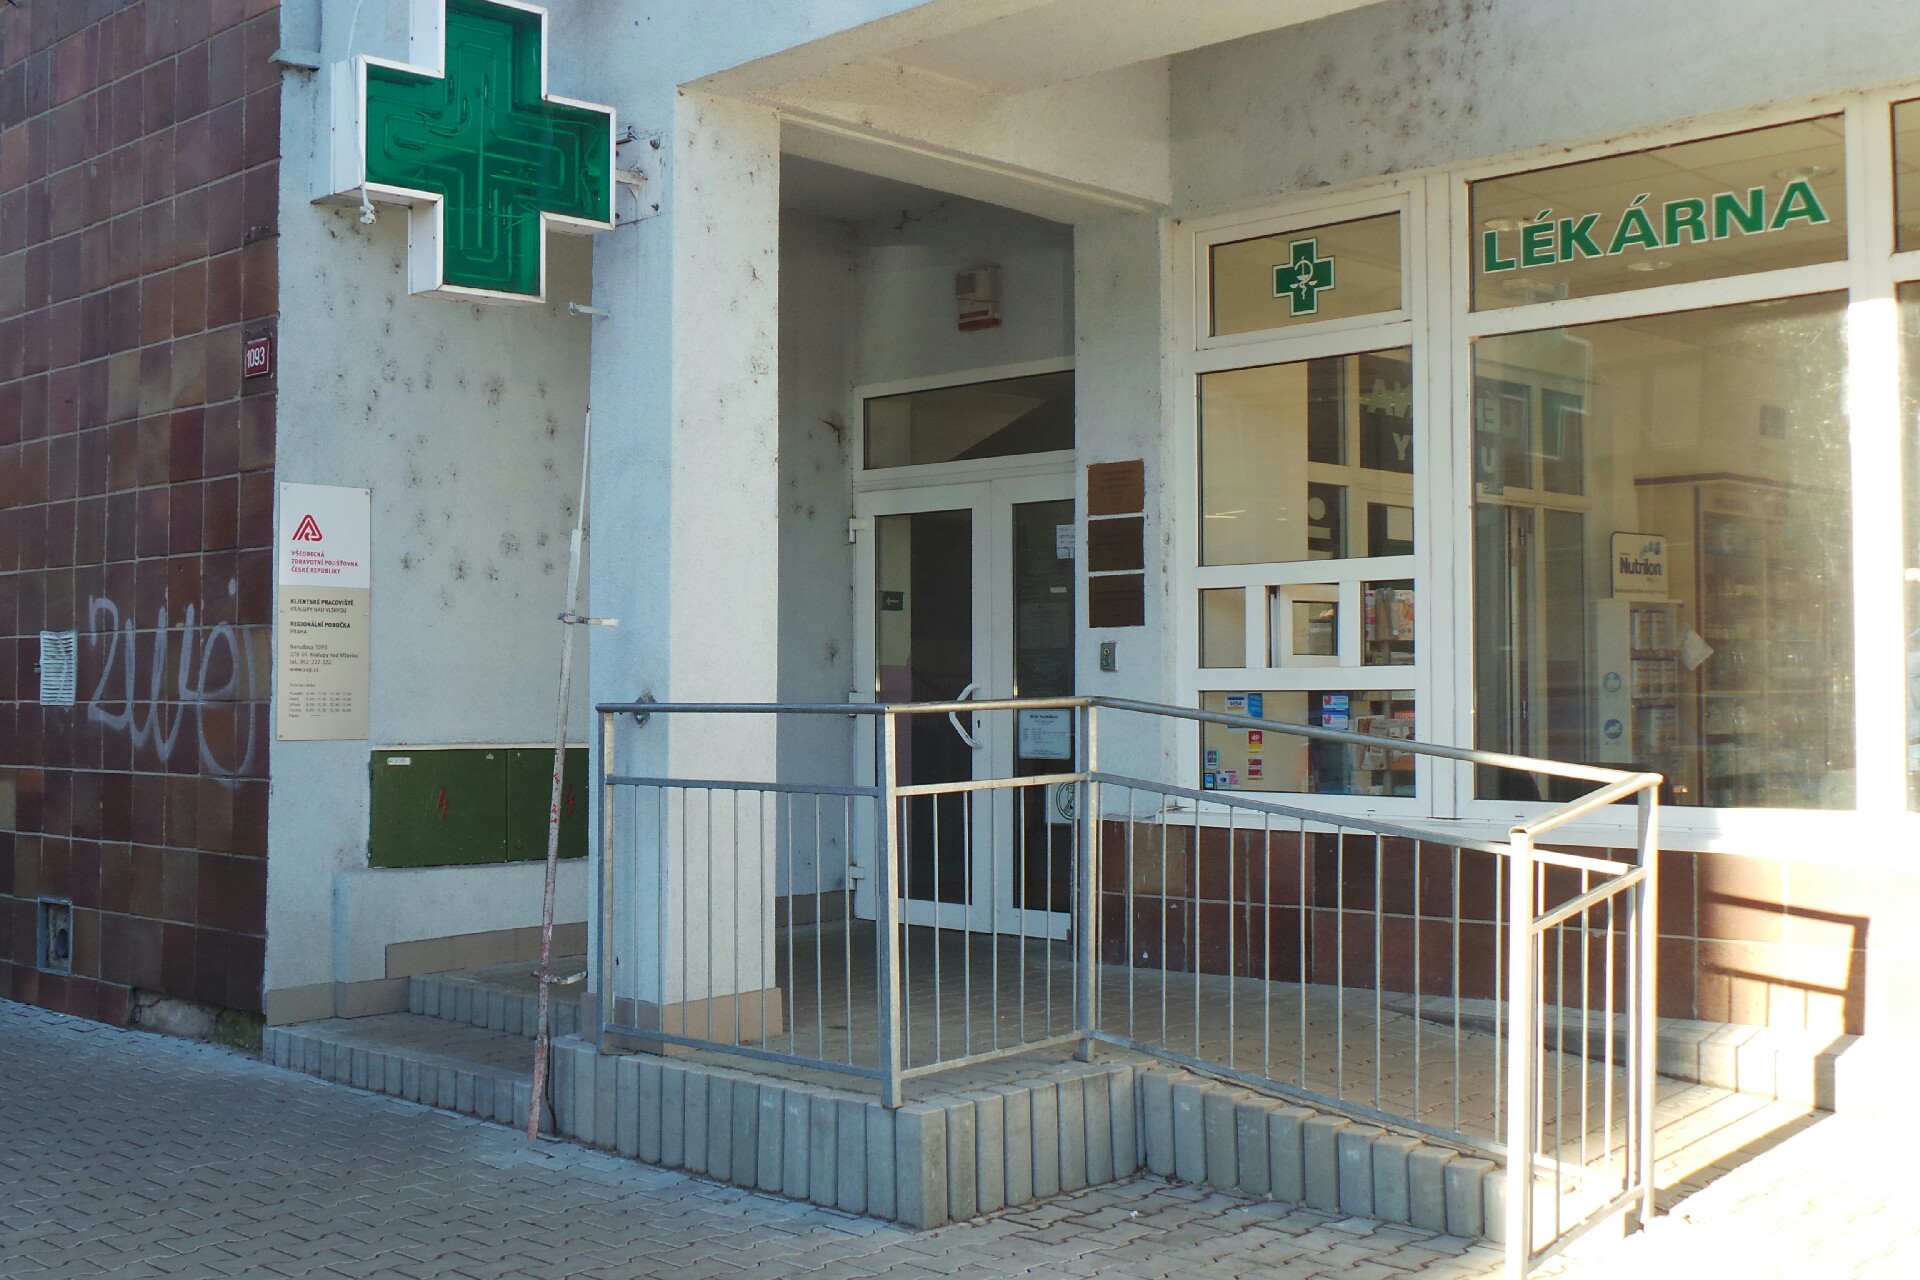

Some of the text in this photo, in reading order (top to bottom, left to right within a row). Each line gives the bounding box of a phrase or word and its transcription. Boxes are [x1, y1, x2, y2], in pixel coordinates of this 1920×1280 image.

[1483, 179, 1830, 274] LÉKÁRNA
[247, 346, 265, 369] 1093
[291, 565, 309, 573] ČESKÉ
[325, 559, 359, 567] POJIŠŤOVNA
[1620, 556, 1662, 576] Nutrilon
